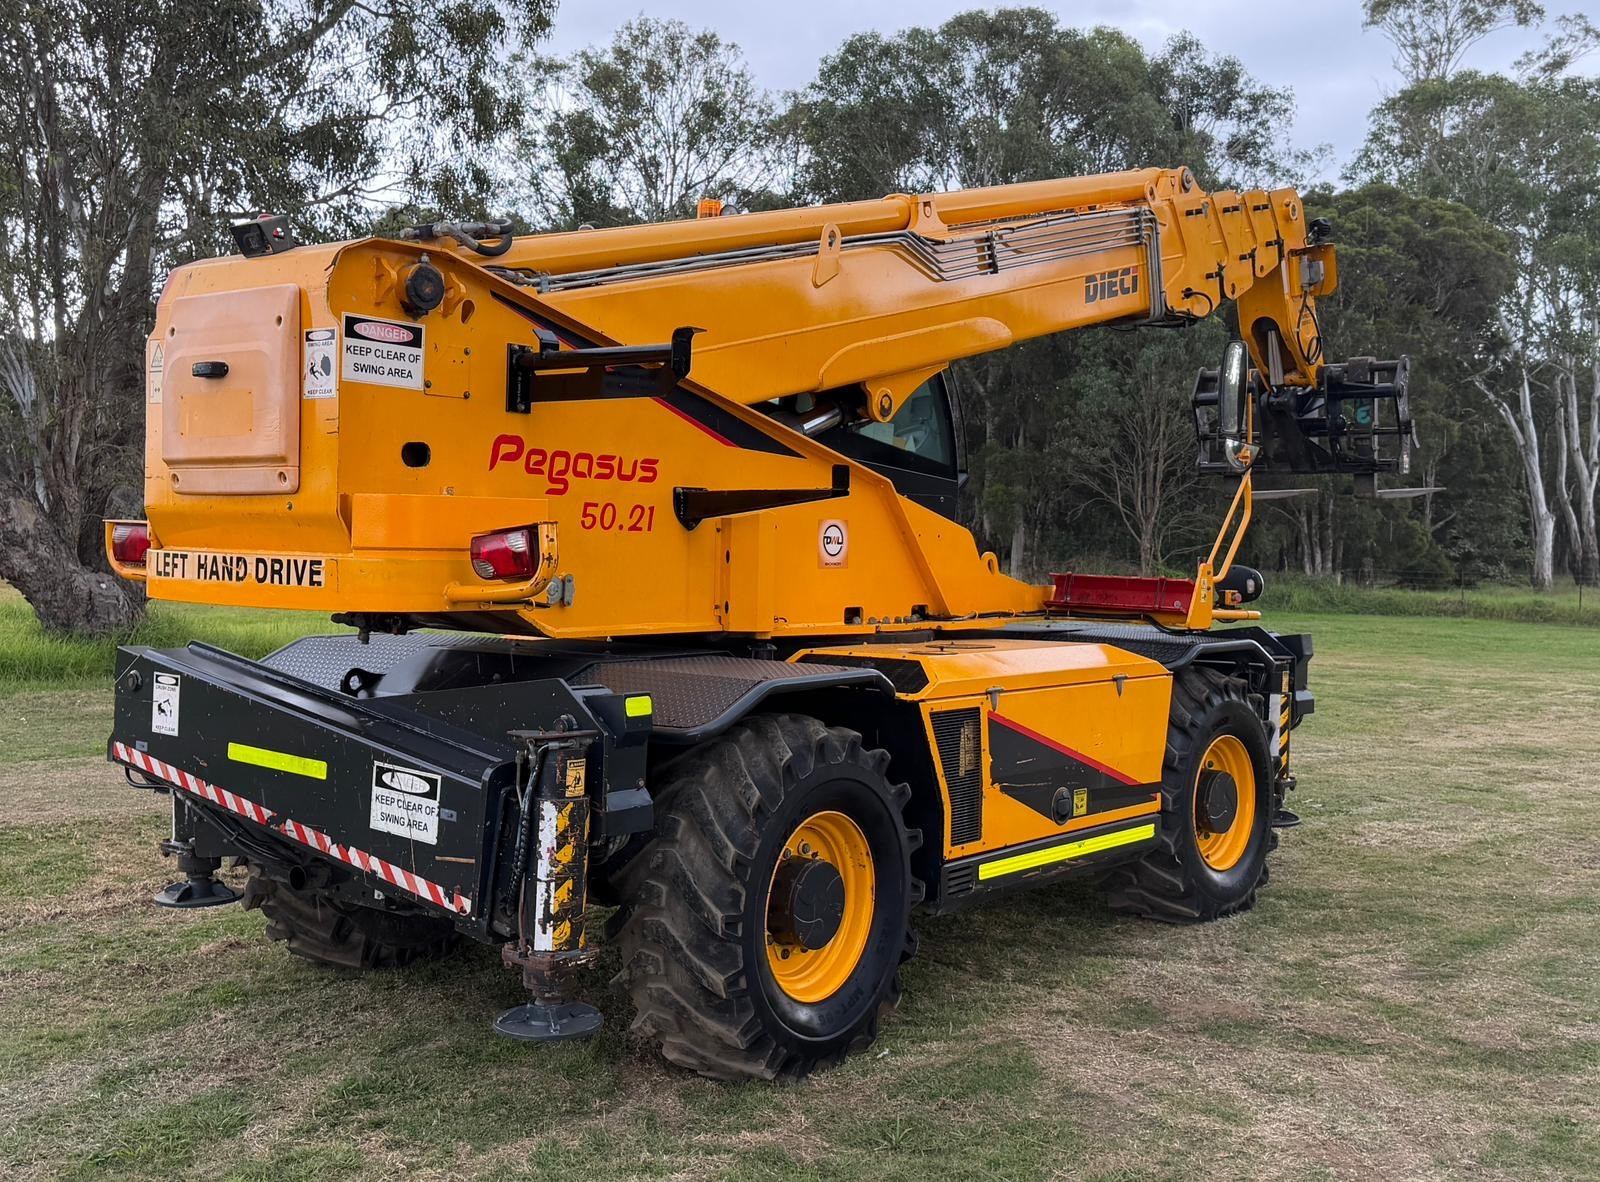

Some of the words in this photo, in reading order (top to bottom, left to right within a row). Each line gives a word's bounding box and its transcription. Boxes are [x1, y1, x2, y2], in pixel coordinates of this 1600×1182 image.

[1085, 265, 1138, 304] DIECI
[361, 325, 408, 341] DANGER
[346, 344, 372, 357] KEEP
[374, 348, 406, 362] CLEAR
[408, 353, 421, 364] OF
[353, 362, 385, 376] SWING
[387, 366, 413, 380] AREA
[489, 433, 660, 496] Pegasus
[580, 502, 656, 532] 50.21
[155, 551, 188, 579] LEFT
[197, 554, 248, 583] HAND
[255, 557, 323, 587] DRIVE
[375, 794, 395, 806] KEEP
[397, 799, 423, 813] CLEAR
[424, 805, 436, 816] OF
[380, 812, 405, 826] SWING
[406, 819, 428, 832] AREA
